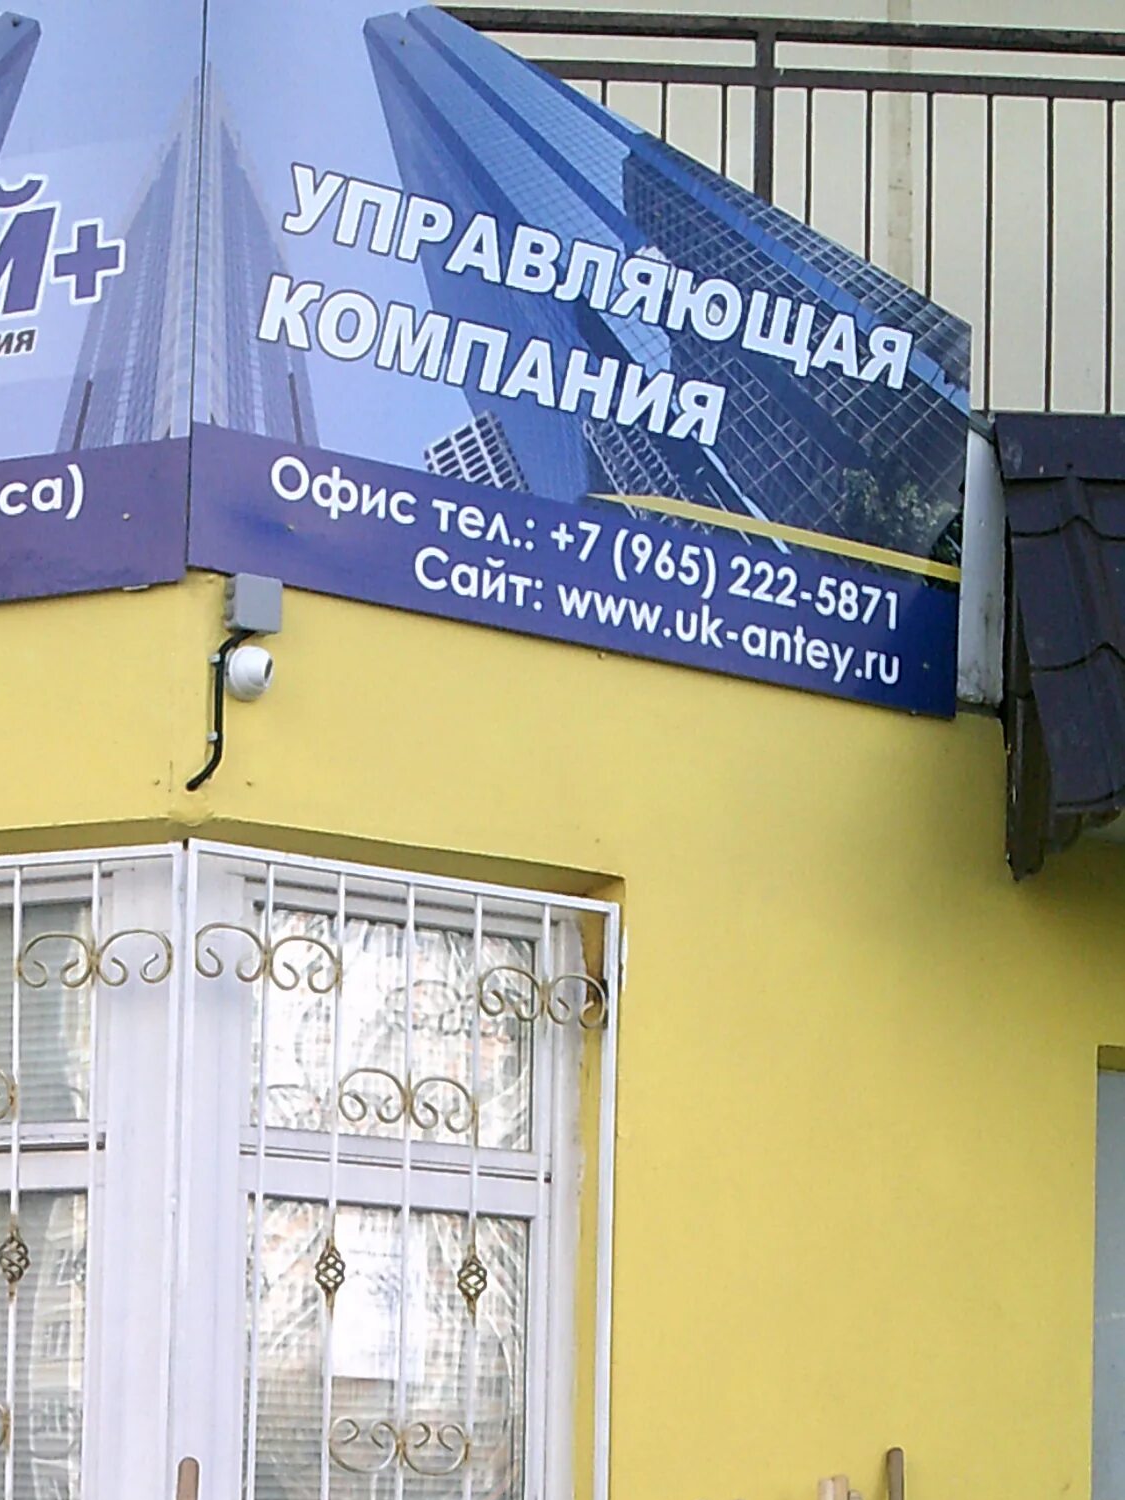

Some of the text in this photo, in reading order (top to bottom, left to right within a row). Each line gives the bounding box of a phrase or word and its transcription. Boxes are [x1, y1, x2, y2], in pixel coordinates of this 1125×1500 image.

[257, 275, 727, 447] КОМПАНИЯ
[282, 161, 914, 391] УПРАВЛЯЮЩАЯ
[270, 456, 900, 630] Офис тел.: +7 (965) 222-5871
[414, 547, 900, 686] Сайт: www.uk-antey.ru
